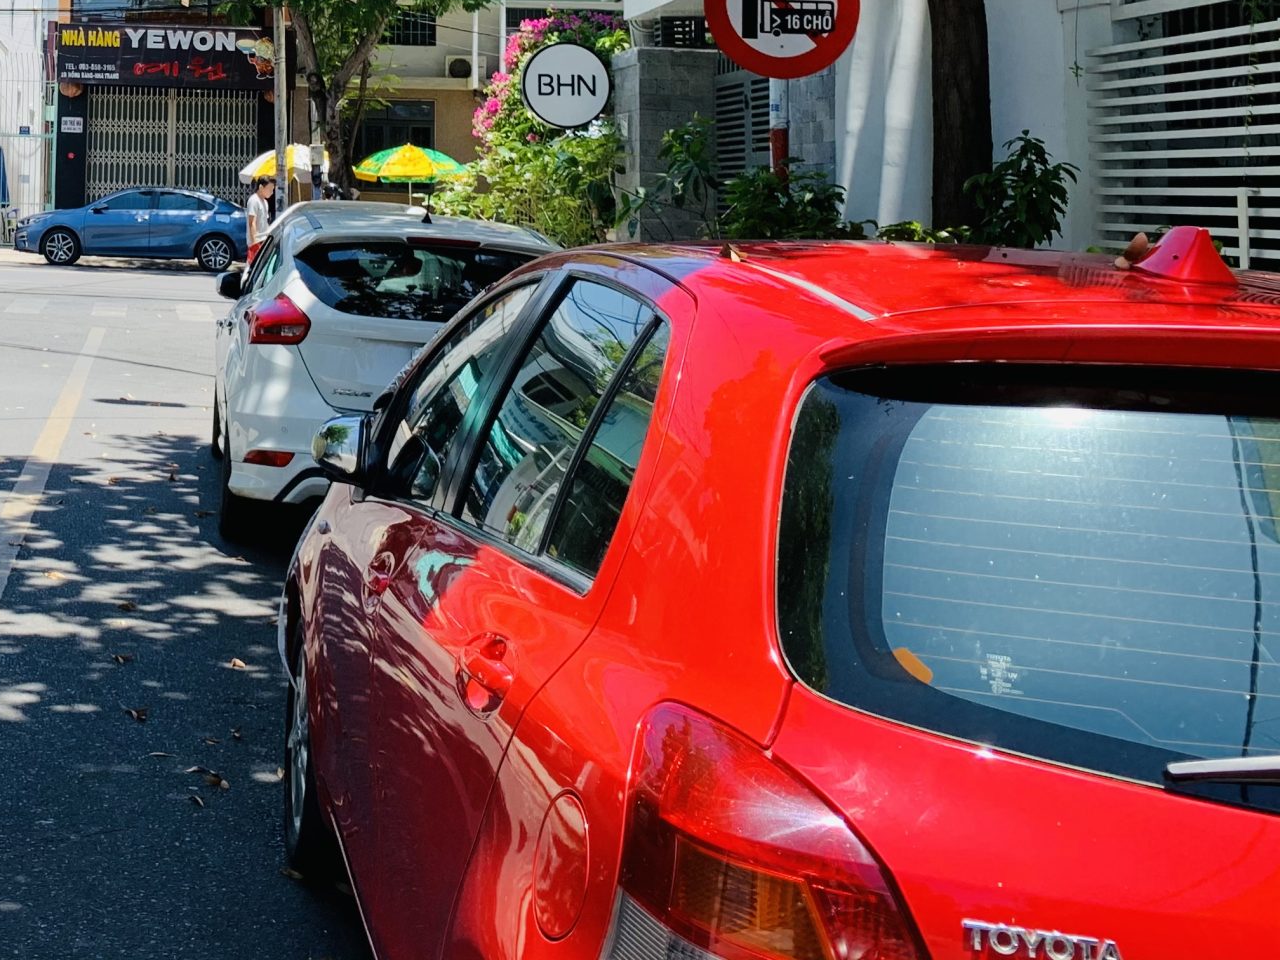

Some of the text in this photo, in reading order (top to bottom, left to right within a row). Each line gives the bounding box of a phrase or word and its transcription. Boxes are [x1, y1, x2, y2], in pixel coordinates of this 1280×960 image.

[785, 14, 800, 29] 16
[61, 26, 236, 52] NHÀ HÀNG YEWON
[537, 73, 597, 97] BHN
[961, 918, 1123, 960] TOYOTA
